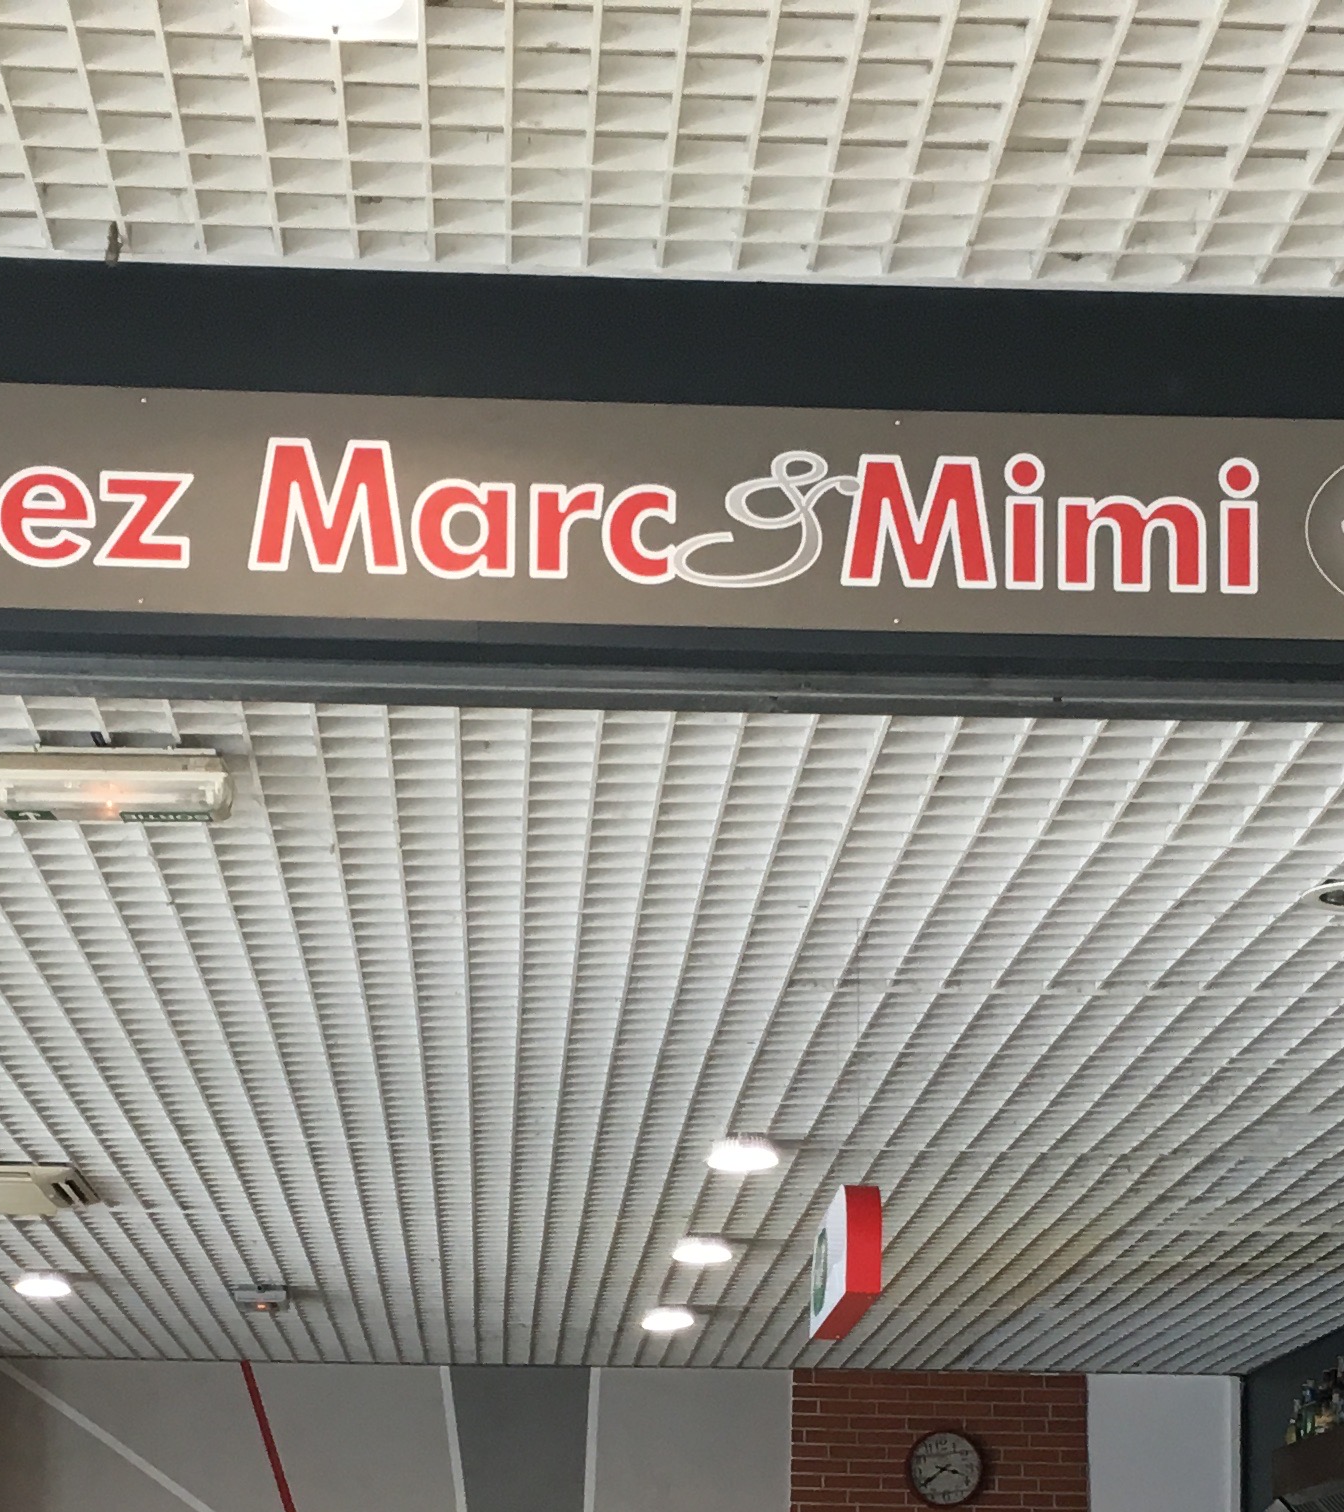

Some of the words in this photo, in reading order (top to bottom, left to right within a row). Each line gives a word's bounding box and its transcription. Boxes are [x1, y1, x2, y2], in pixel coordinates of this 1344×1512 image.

[248, 437, 677, 584] Marc
[673, 450, 861, 589] &
[841, 452, 1259, 595] Mimi
